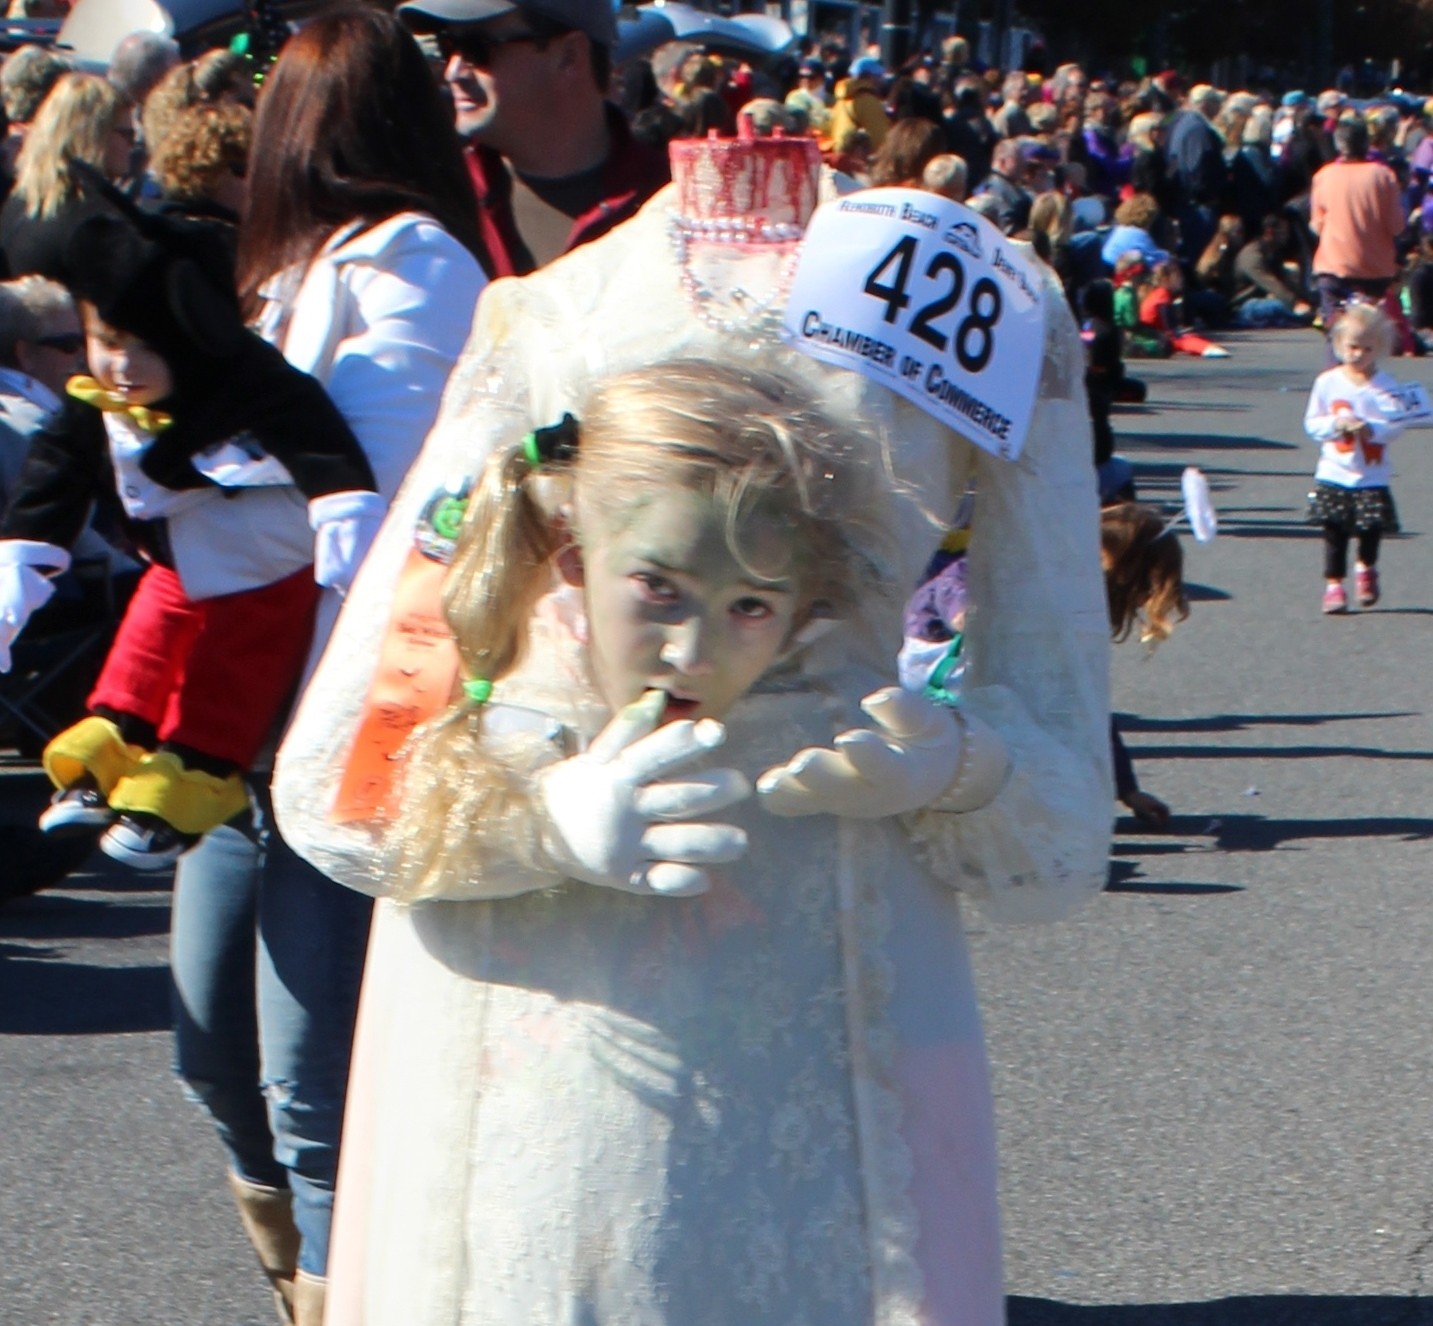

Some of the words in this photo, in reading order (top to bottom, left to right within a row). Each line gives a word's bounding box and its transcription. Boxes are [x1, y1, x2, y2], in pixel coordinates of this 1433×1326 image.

[863, 235, 1004, 374] 428
[801, 310, 898, 367] CHAMBER
[900, 355, 924, 382] OF
[925, 363, 1013, 441] COMMERCE
